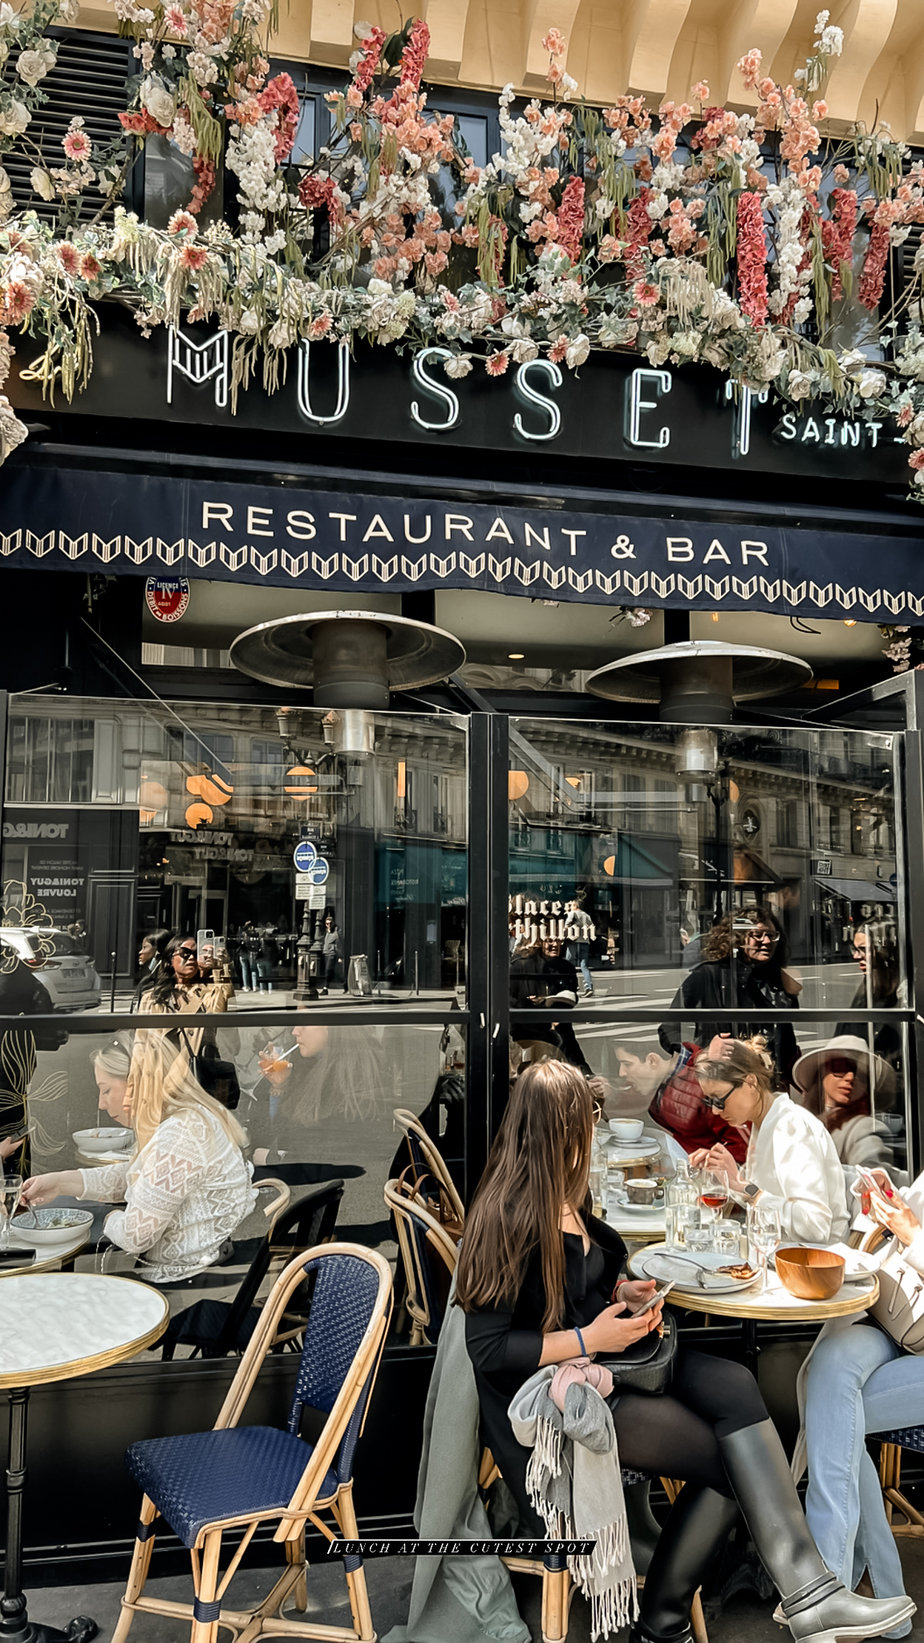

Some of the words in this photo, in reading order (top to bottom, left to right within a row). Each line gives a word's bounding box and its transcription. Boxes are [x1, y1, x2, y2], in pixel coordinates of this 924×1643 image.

[166, 324, 768, 455] MUSSET
[202, 501, 587, 557] RESTAURANT
[610, 535, 637, 560] &
[666, 536, 770, 567] BAR
